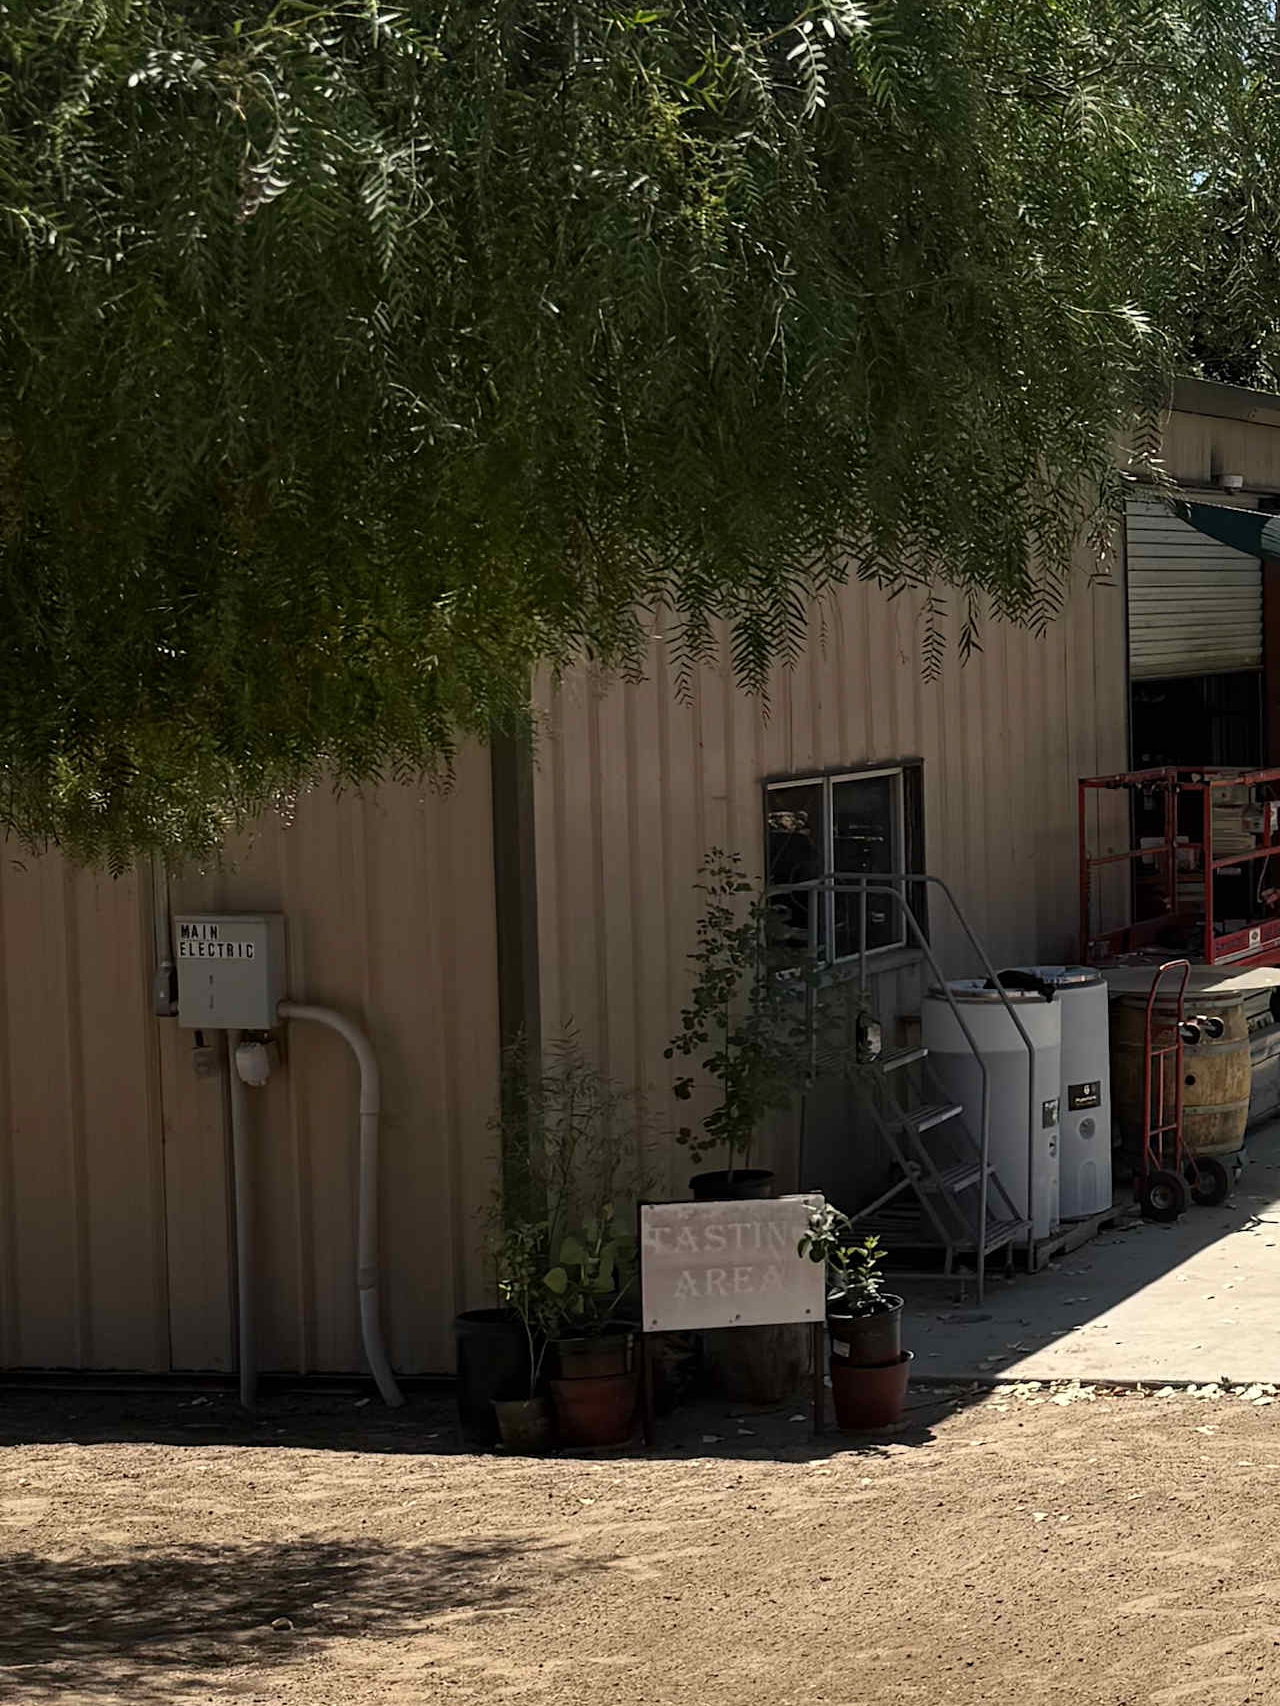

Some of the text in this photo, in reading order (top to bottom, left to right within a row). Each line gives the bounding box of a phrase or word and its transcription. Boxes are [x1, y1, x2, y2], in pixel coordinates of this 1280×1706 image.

[180, 924, 218, 940] MAIN
[180, 941, 254, 958] ELECTRIC
[648, 1221, 804, 1254] TASTIN
[672, 1264, 785, 1299] AREA
